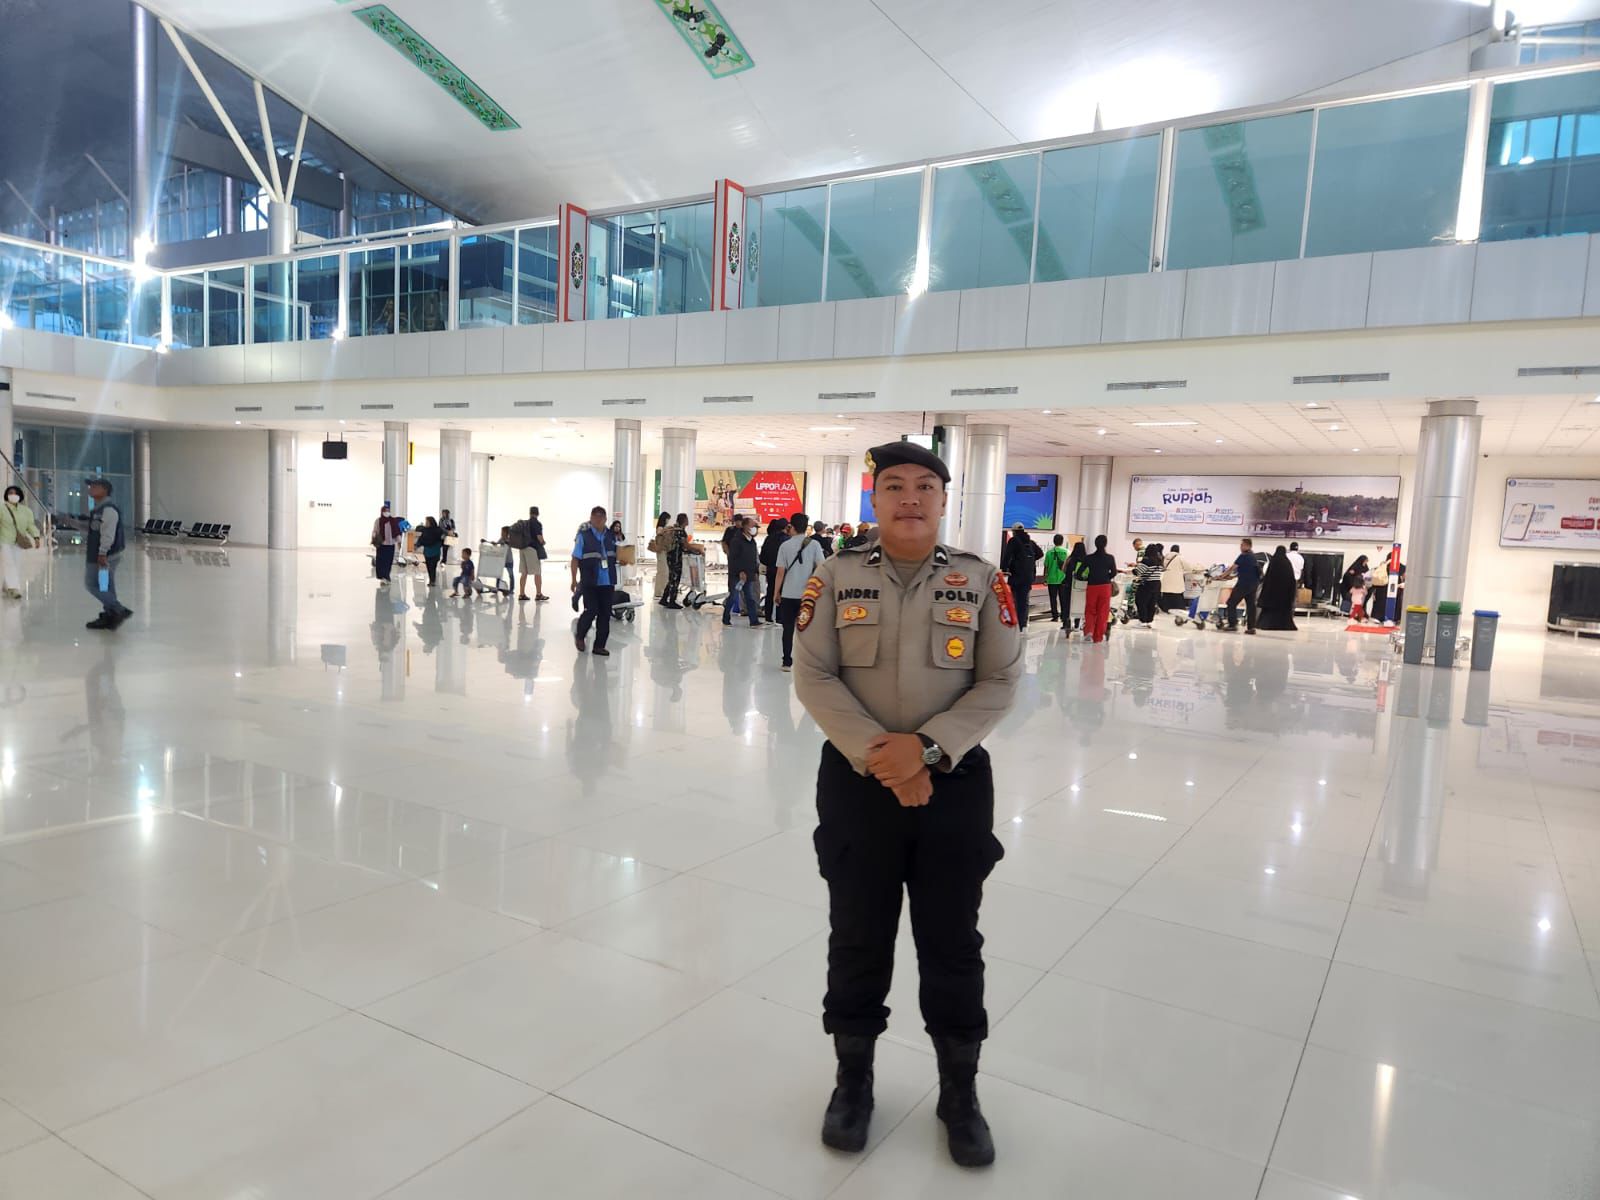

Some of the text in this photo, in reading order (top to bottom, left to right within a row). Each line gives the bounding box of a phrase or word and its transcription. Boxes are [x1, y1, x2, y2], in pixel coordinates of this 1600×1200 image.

[1162, 492, 1213, 505] Rupiah
[837, 588, 880, 602] ANDRE
[934, 590, 979, 605] POLRI
